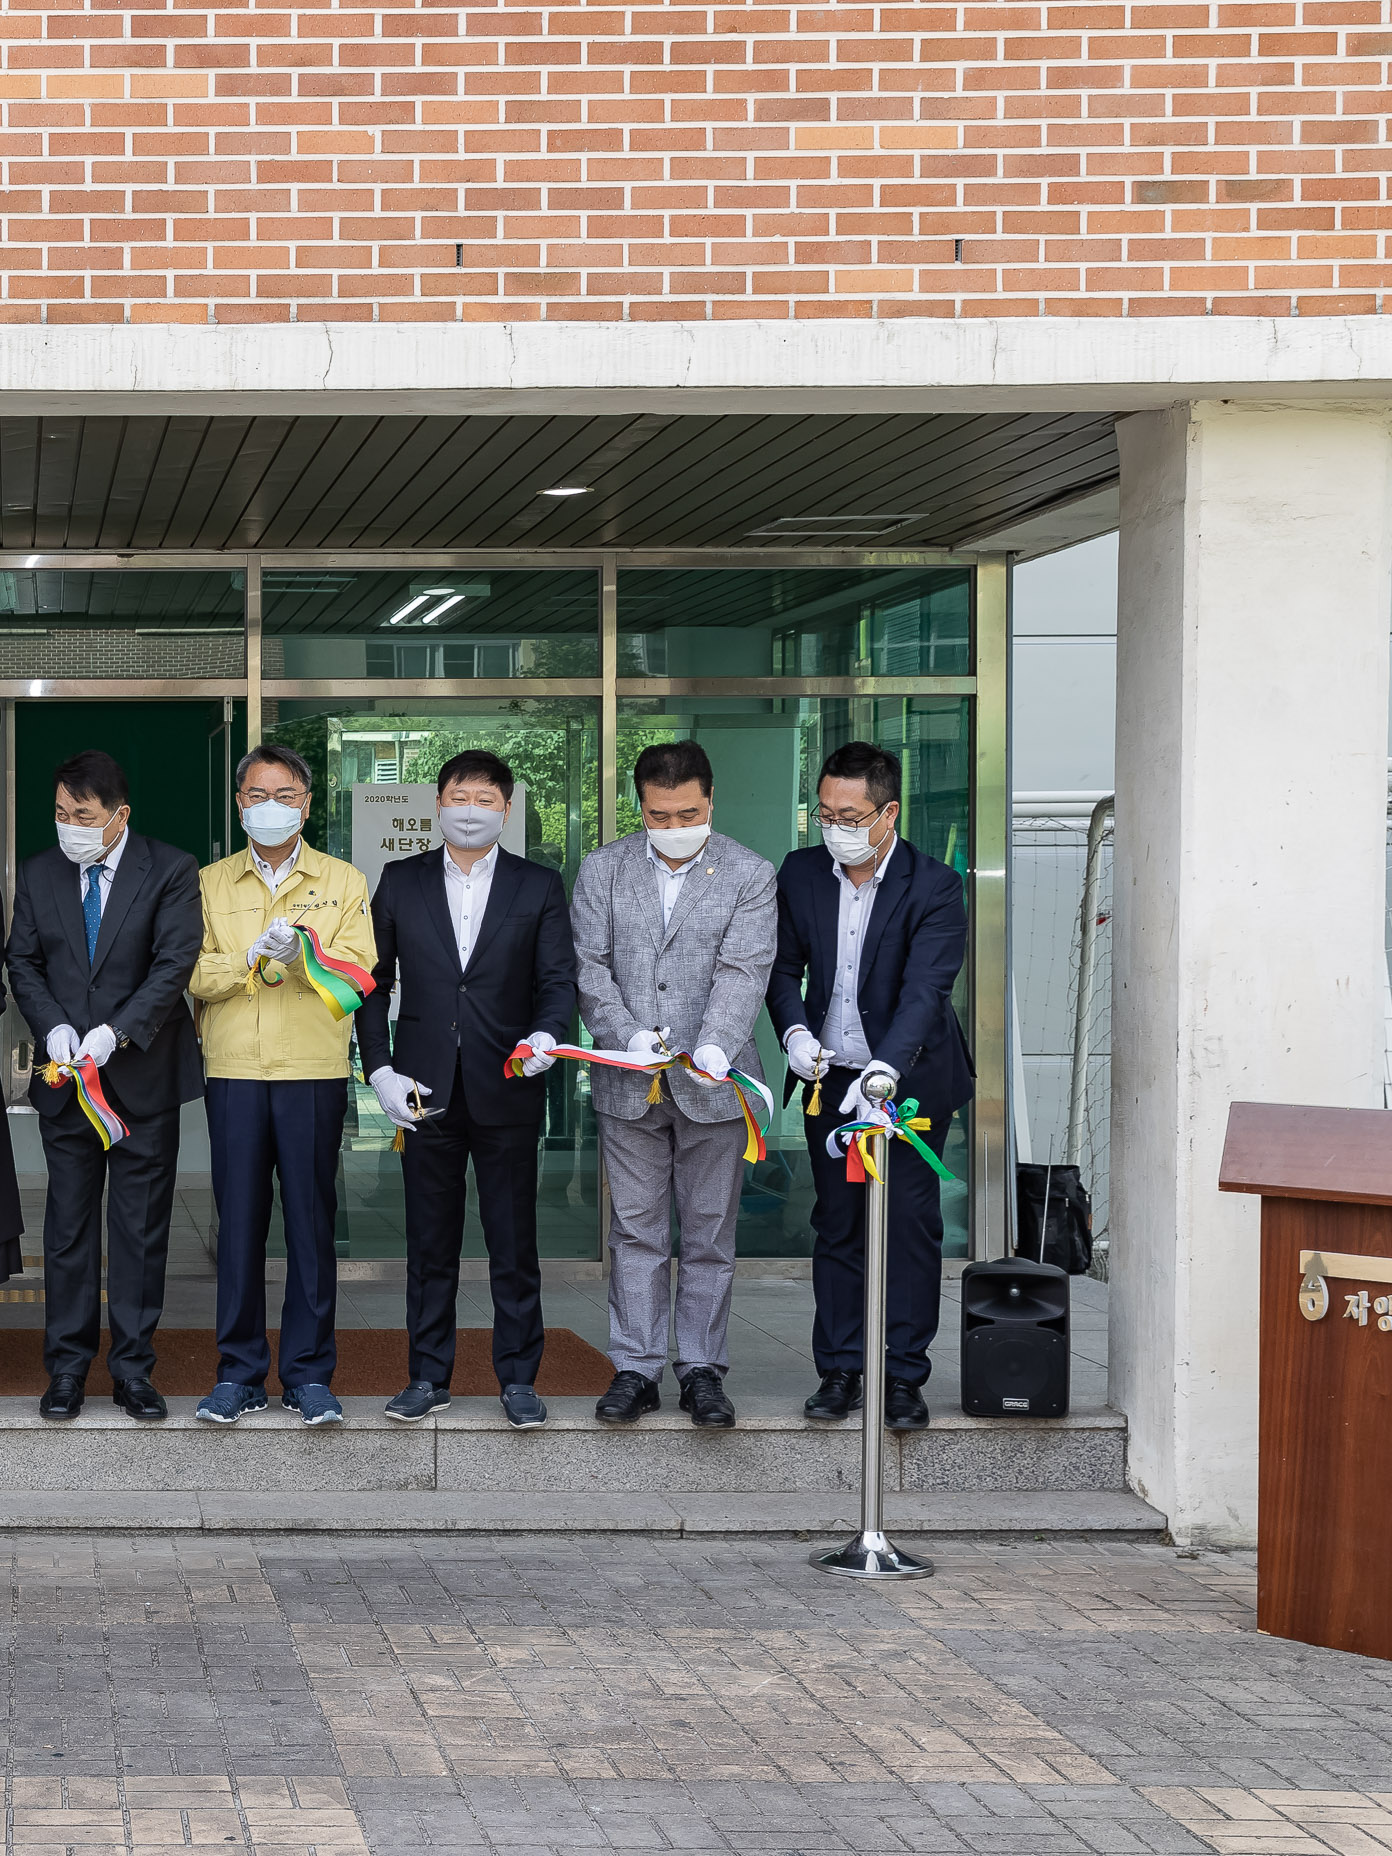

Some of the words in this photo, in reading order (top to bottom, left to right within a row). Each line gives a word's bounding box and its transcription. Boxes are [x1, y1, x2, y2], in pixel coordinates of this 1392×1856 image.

[364, 795, 409, 803] 2020학년도
[391, 817, 432, 832] 해오름
[380, 837, 432, 852] 새단장
